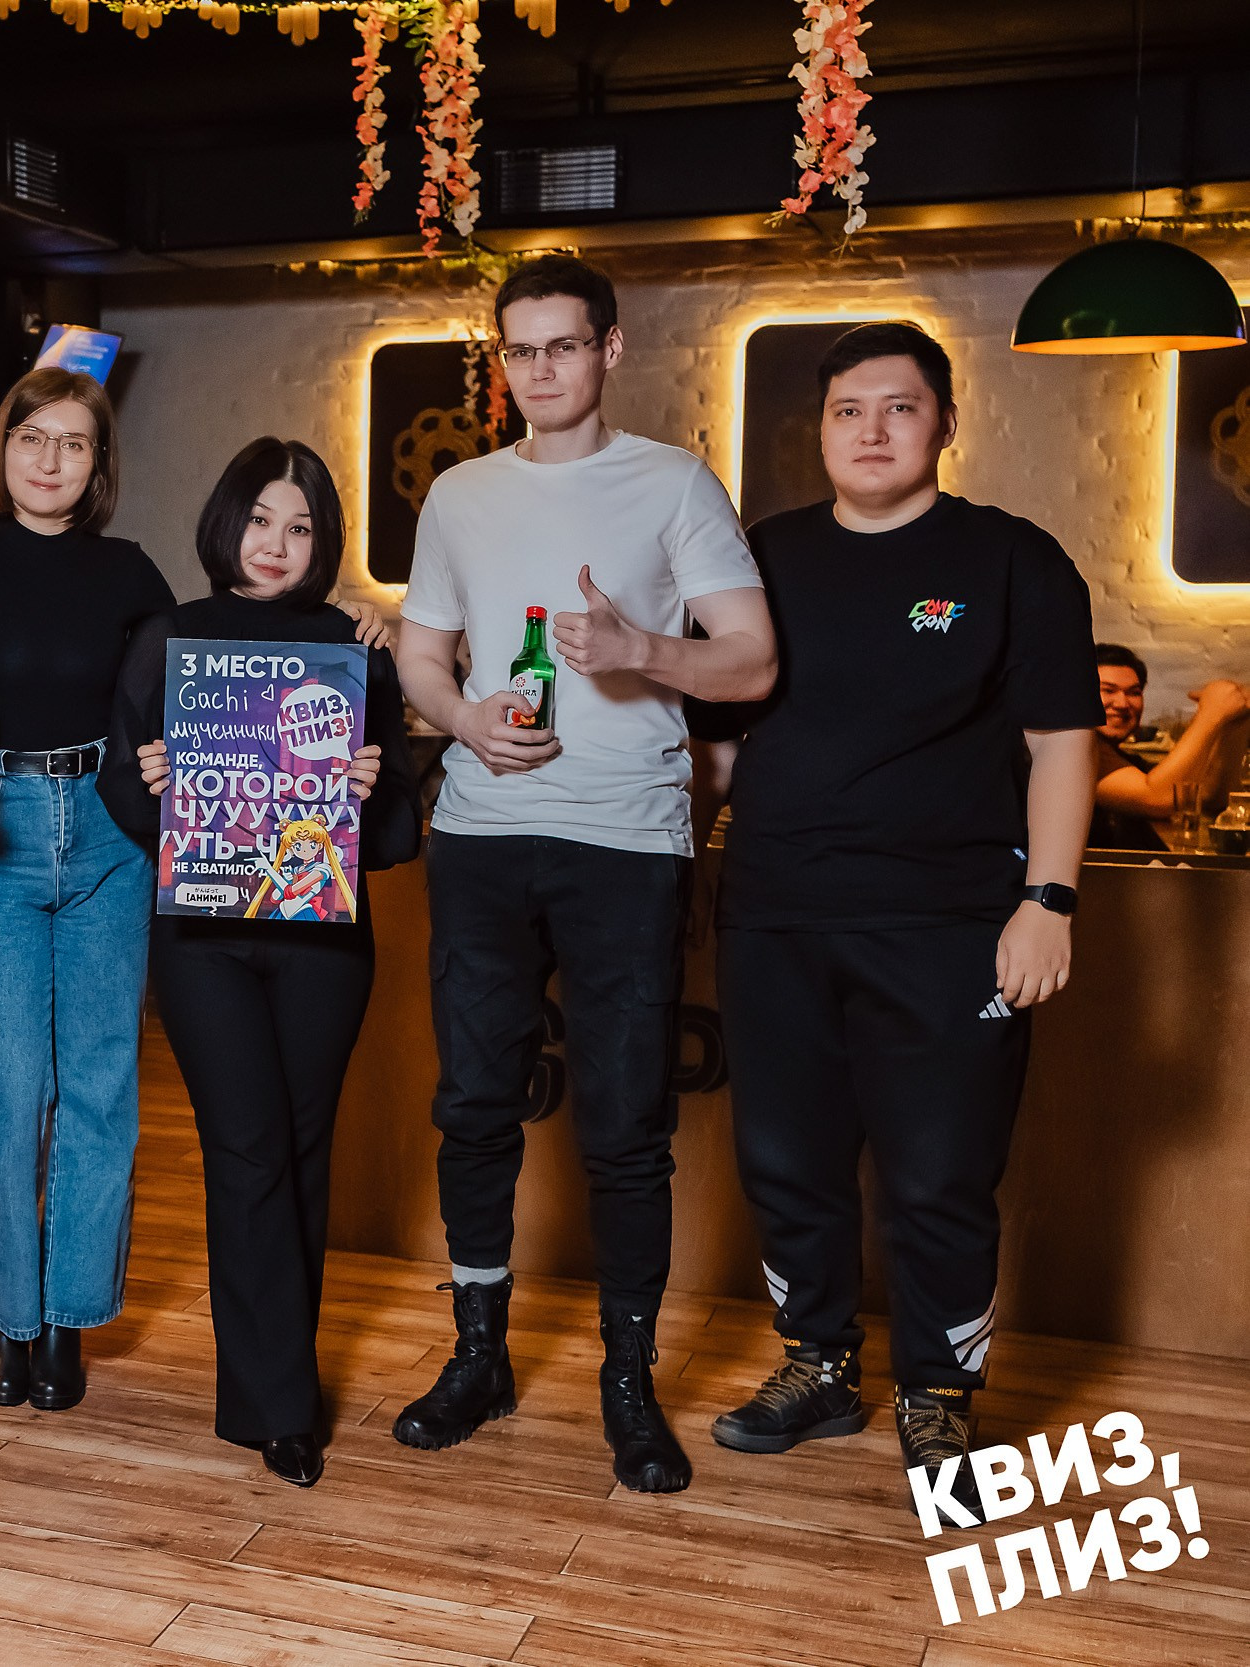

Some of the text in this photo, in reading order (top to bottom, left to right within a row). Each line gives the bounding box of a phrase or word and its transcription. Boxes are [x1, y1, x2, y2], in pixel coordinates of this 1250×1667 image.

[908, 599, 966, 619] COMIC
[911, 614, 953, 634] CON
[180, 653, 306, 680] 3 МЕСТО
[178, 681, 249, 712] Gachi
[279, 694, 350, 727] КВИЗ,
[175, 751, 263, 770] КОМАНДЕ,
[174, 768, 348, 802] КОТОРОЙ
[171, 861, 189, 873] НЕ
[191, 862, 256, 876] ХВАТИЛО
[186, 892, 227, 904] [АНИМЕ]
